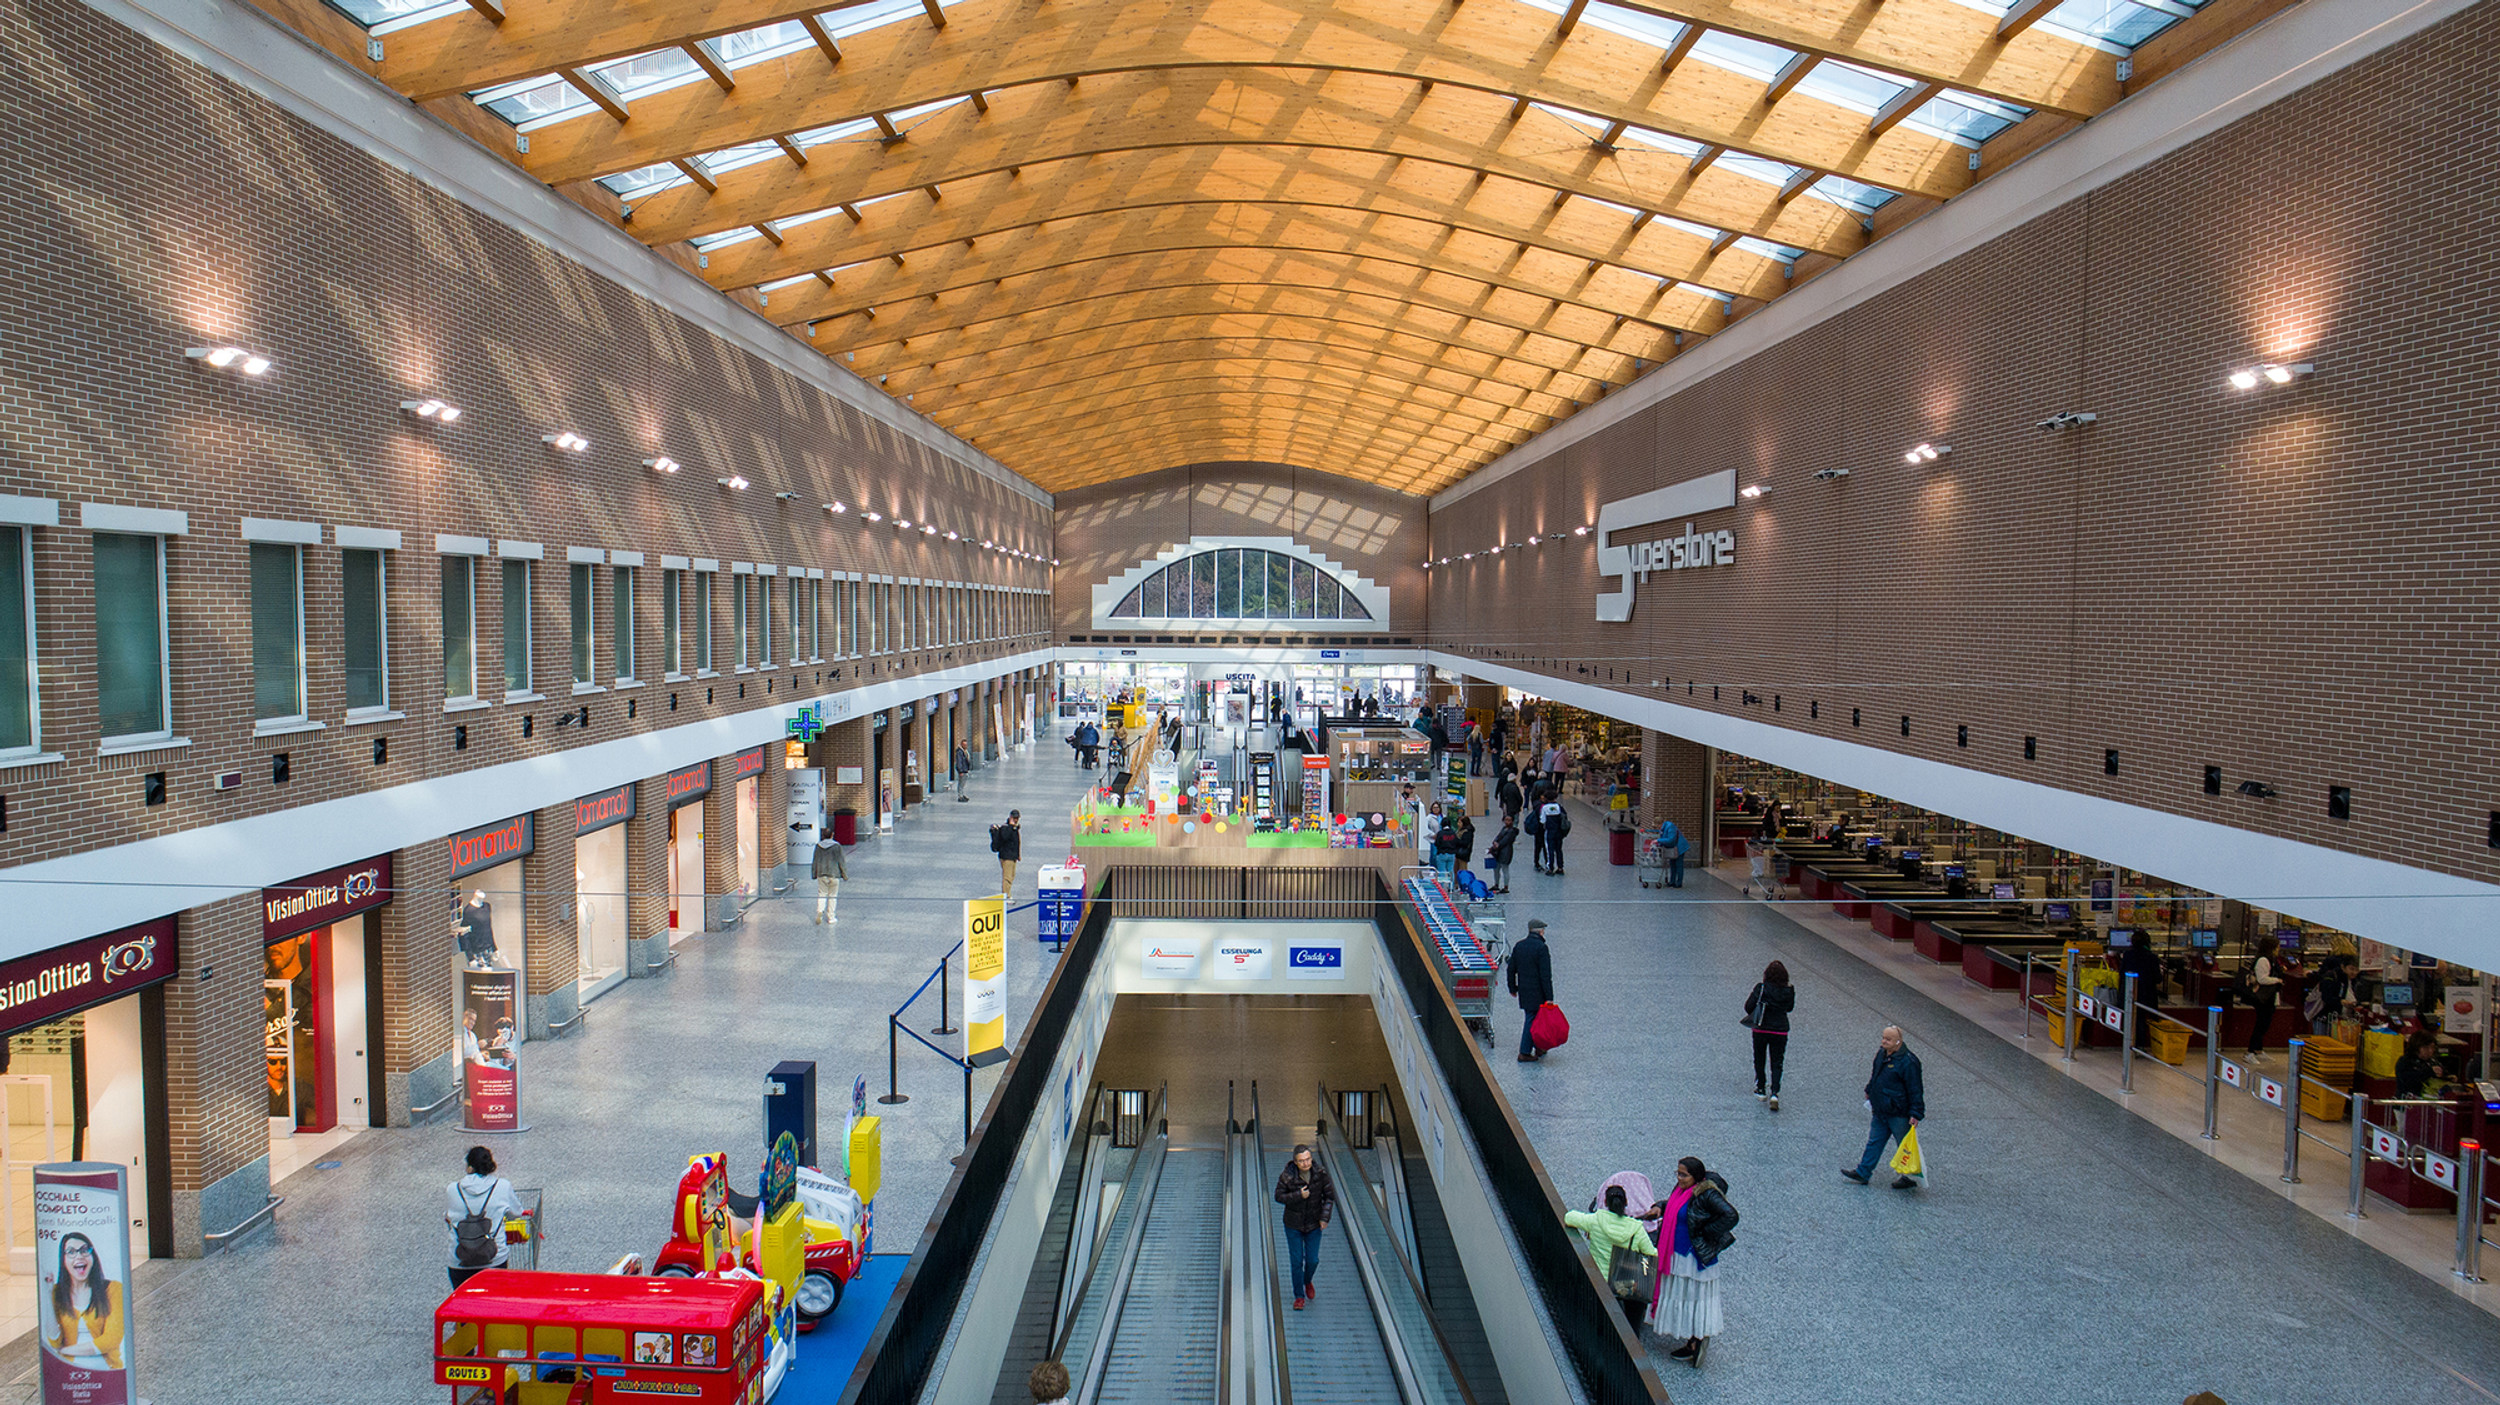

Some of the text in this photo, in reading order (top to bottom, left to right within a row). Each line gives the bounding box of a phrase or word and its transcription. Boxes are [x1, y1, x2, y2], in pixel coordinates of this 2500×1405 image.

[1596, 469, 1737, 622] Superstore
[972, 913, 1000, 934] QUI
[1296, 949, 1335, 964] Caddy's
[36, 1191, 80, 1202] OCCHIALE
[36, 1203, 111, 1214] COMPLETO con
[448, 1368, 487, 1379] ROUTE 3
